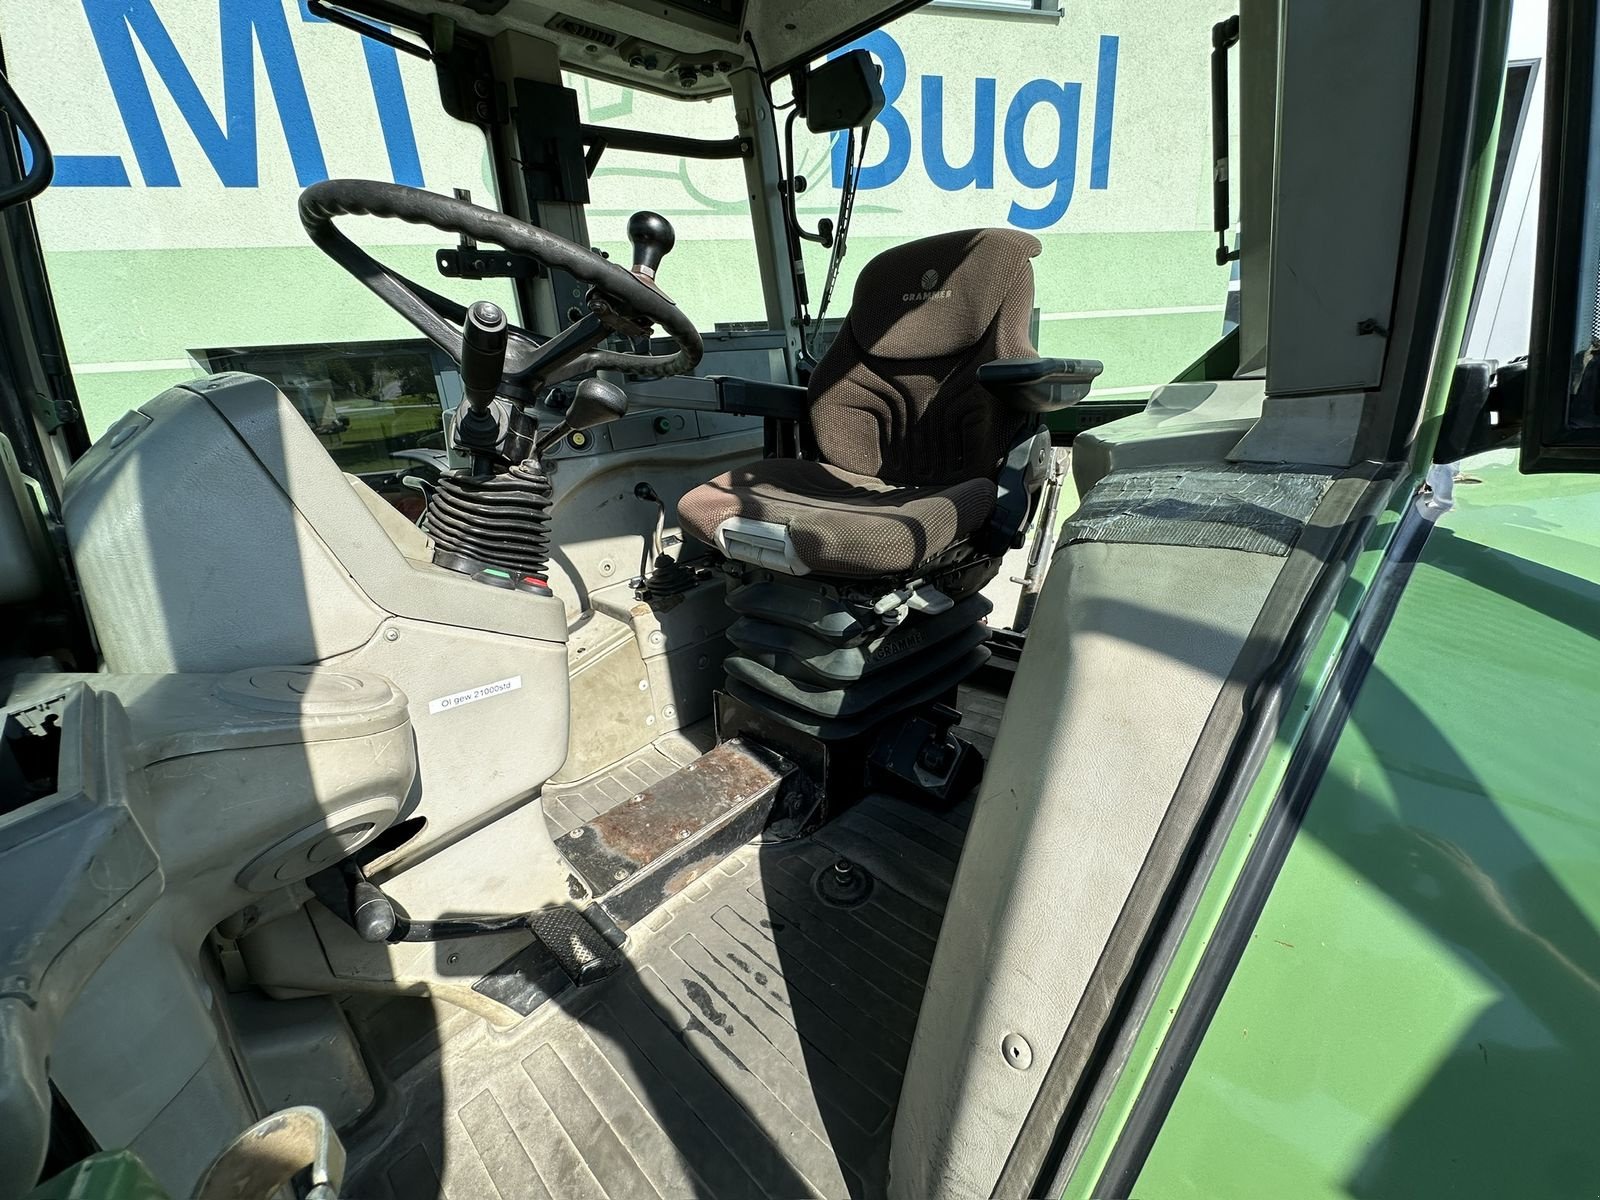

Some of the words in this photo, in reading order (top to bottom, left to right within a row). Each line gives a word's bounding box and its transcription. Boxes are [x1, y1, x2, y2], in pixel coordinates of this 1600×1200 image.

[16, 0, 425, 188] MT
[826, 29, 1120, 230] Bugl
[902, 290, 952, 302] GRAMMER
[454, 693, 472, 705] gew
